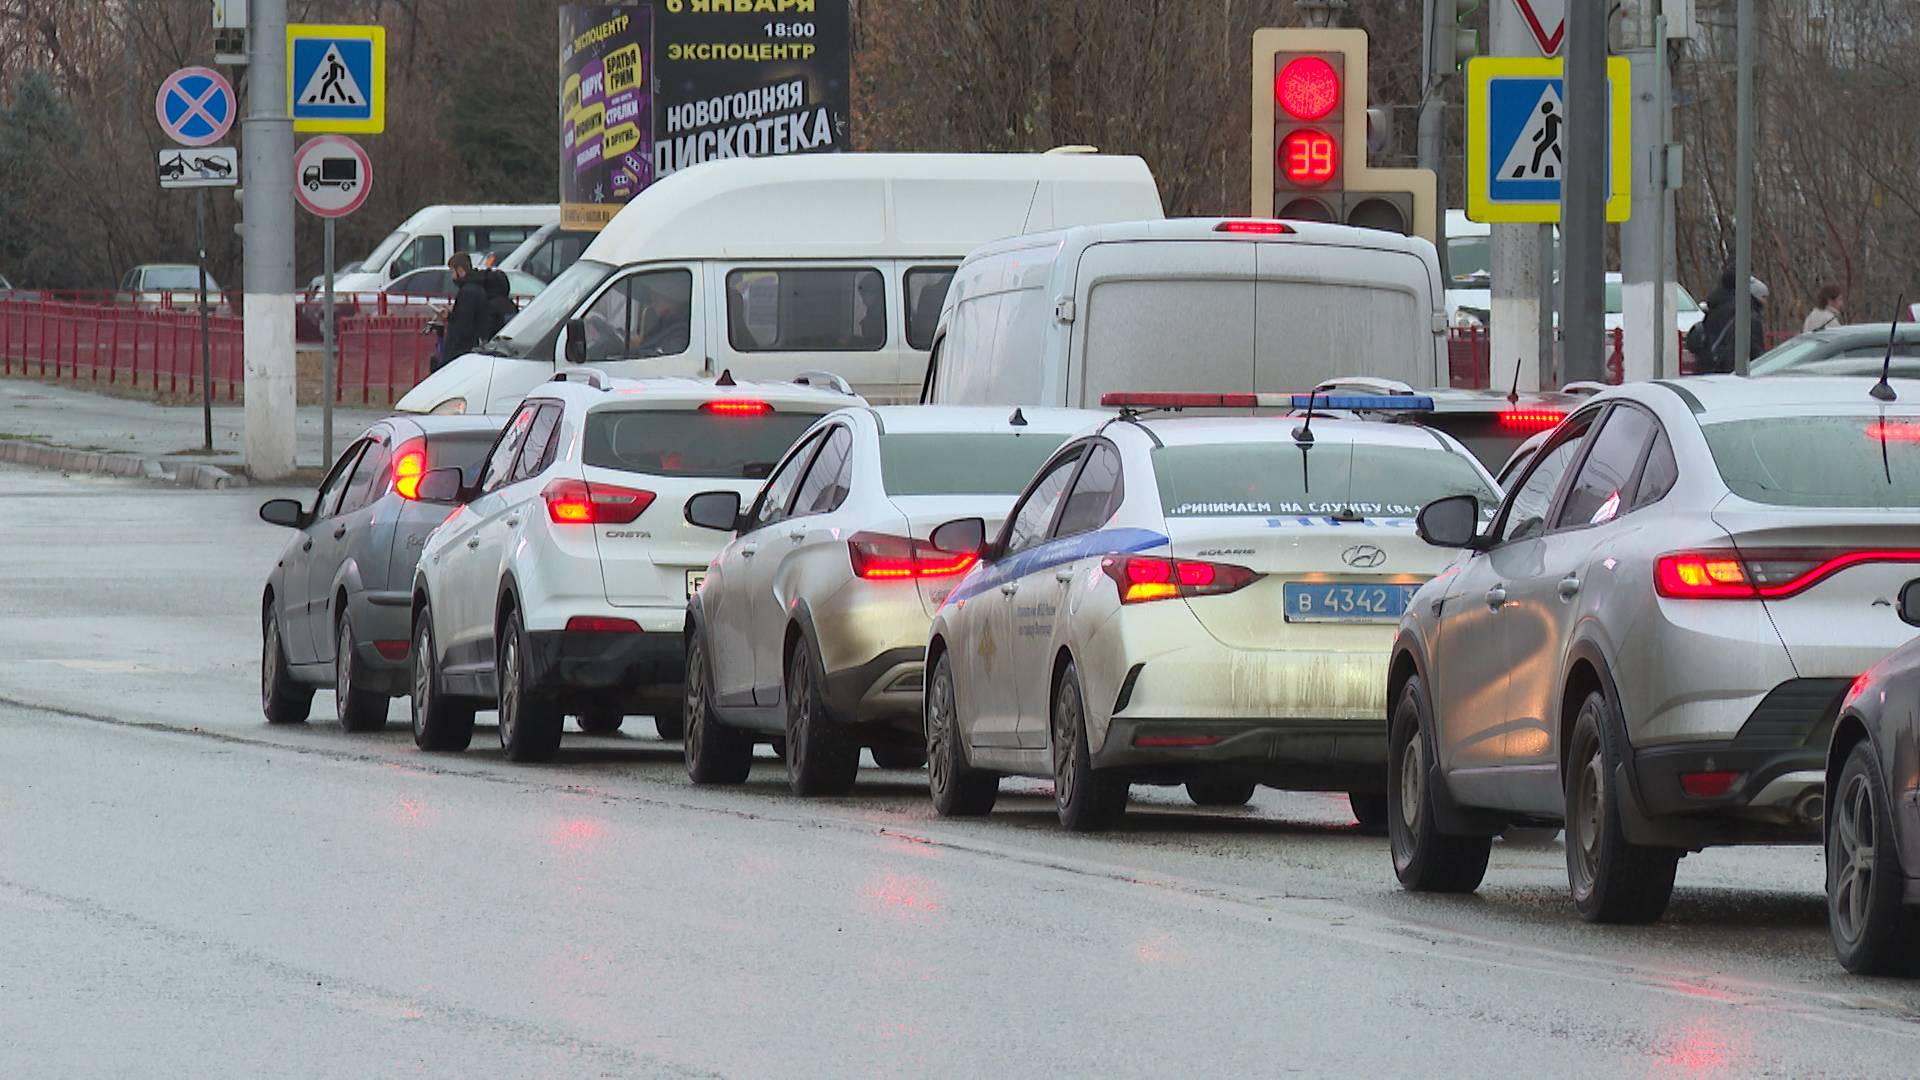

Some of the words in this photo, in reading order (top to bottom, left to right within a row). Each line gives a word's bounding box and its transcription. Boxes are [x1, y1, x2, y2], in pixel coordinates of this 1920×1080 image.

[666, 0, 683, 13] 6
[690, 0, 816, 12] ЯНВАРЯ
[763, 22, 816, 37] 18:00
[606, 49, 637, 74] БРАТЬЯ
[667, 43, 816, 62] ЭКСПОЦЕНТР
[610, 68, 634, 90] ГРИМ
[605, 99, 639, 125] СТРЕЛКИ
[667, 81, 803, 133] НОВОГОДНЯЯ
[655, 107, 833, 179] ДИСКОТЕКА
[1291, 138, 1332, 175] 39
[1170, 502, 1271, 514] РИНИМАЕМ
[1279, 501, 1304, 513] НА
[605, 530, 652, 539] CRETA
[1196, 548, 1256, 557] SOLARIS
[1324, 588, 1387, 613] 4342
